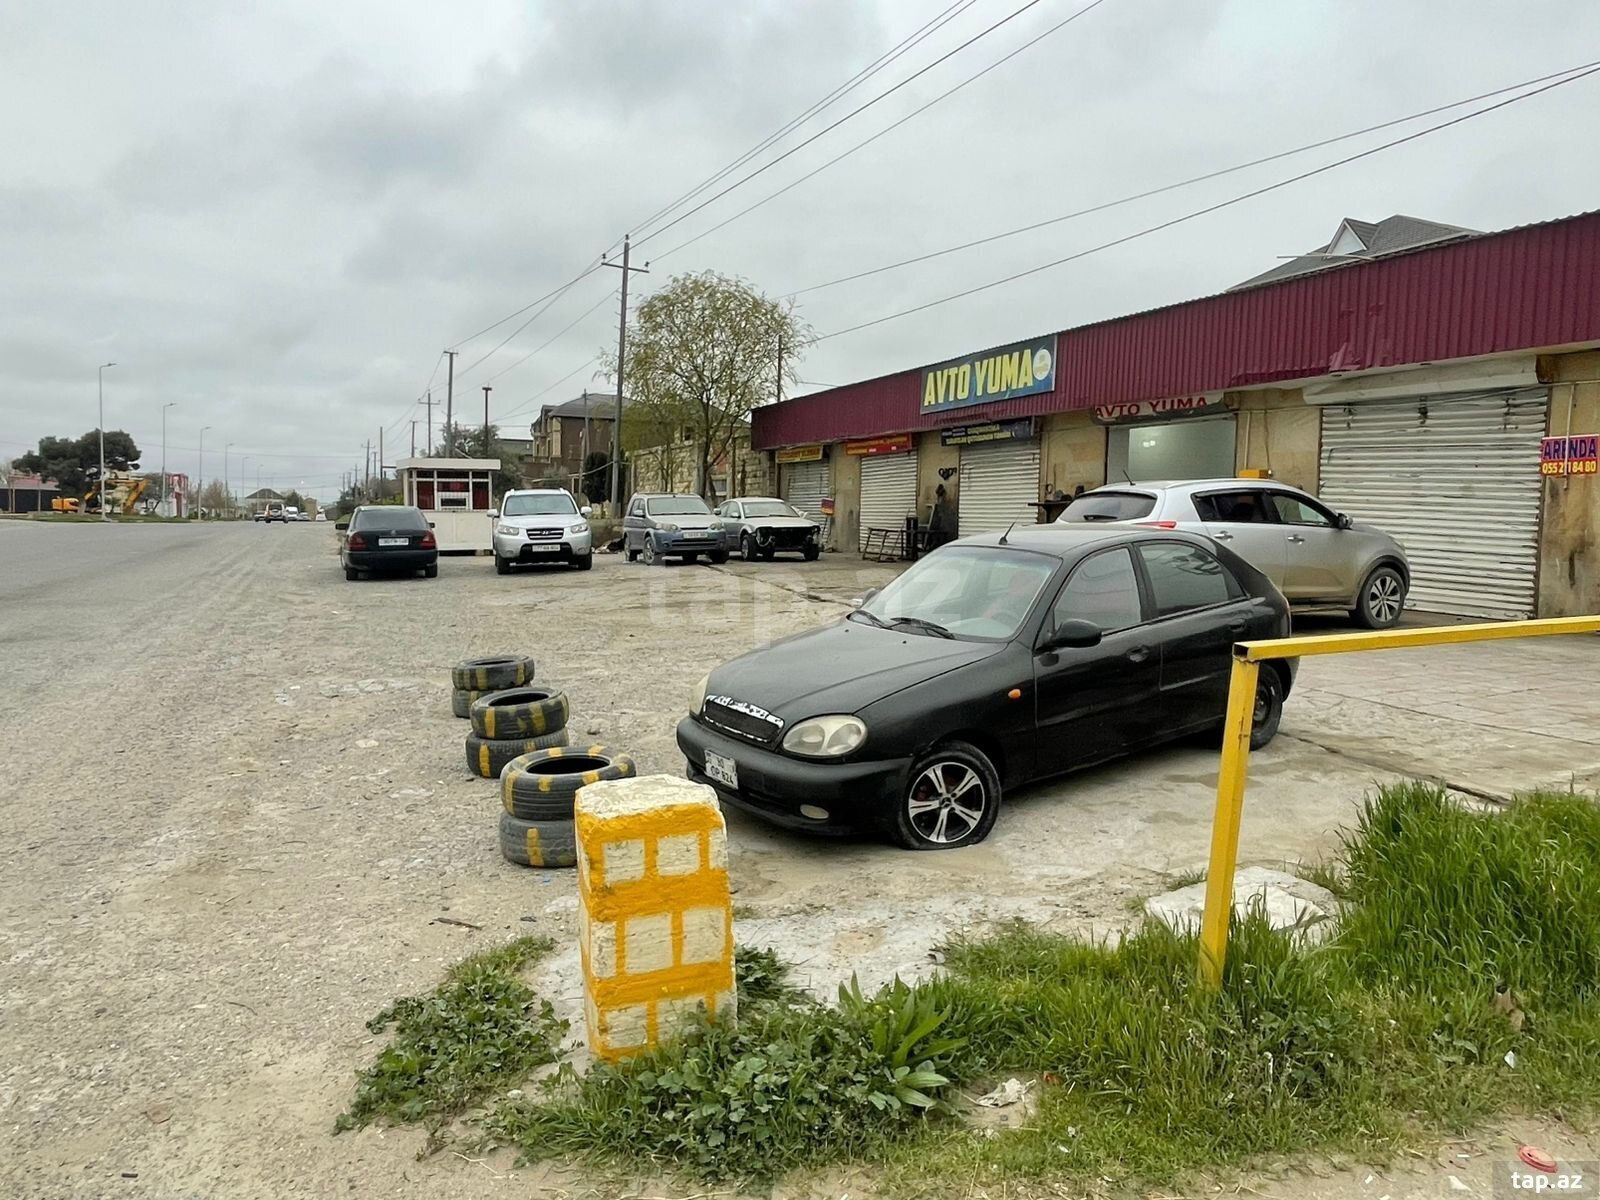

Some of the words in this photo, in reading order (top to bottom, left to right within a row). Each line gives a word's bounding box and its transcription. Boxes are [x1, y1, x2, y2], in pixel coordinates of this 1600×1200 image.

[923, 363, 971, 406] AVTO
[974, 349, 1033, 396] YUMA
[1095, 404, 1140, 418] AVTO
[1149, 396, 1208, 413] YUMA
[1544, 439, 1597, 460] ARENDA
